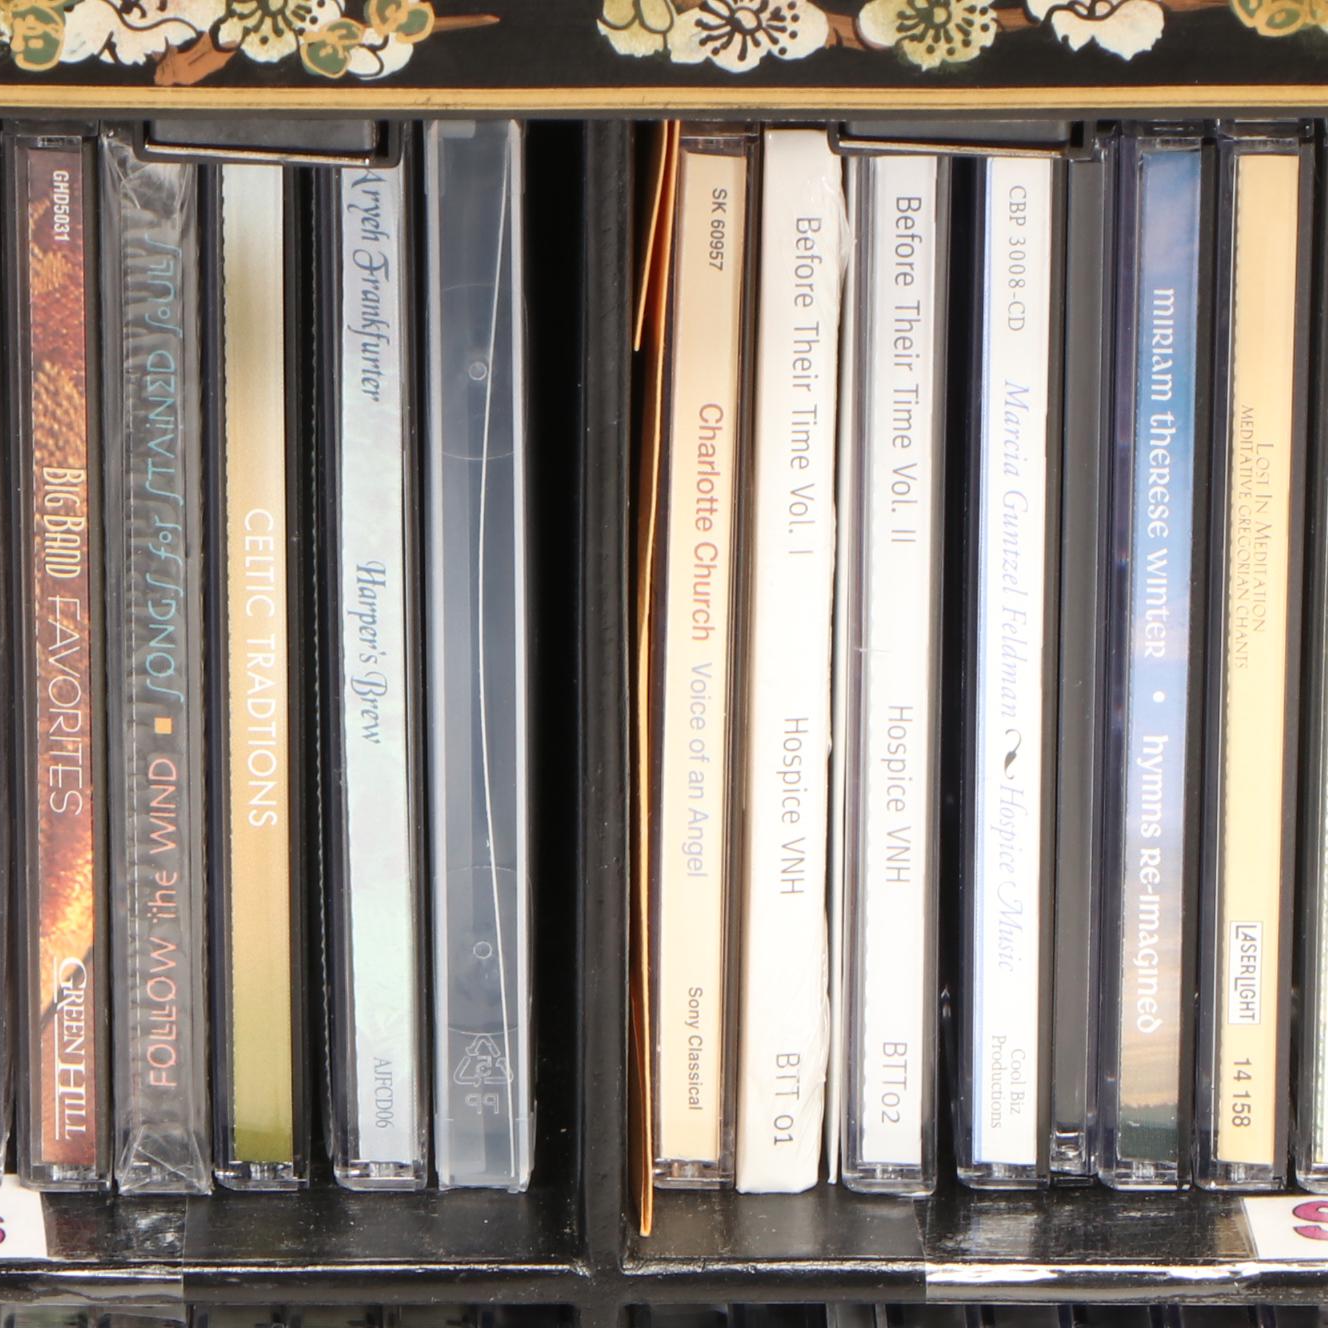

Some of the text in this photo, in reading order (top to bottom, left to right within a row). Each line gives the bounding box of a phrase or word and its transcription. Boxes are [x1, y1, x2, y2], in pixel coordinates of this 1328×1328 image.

[690, 219, 726, 641] 60957 Charlotte Church
[892, 196, 922, 449] Before Their Time
[43, 170, 88, 1139] GHD5031 BIG BAND FAVORITES GREEN HILL
[244, 508, 274, 617] CELTIC
[1231, 1058, 1252, 1127] 14 158
